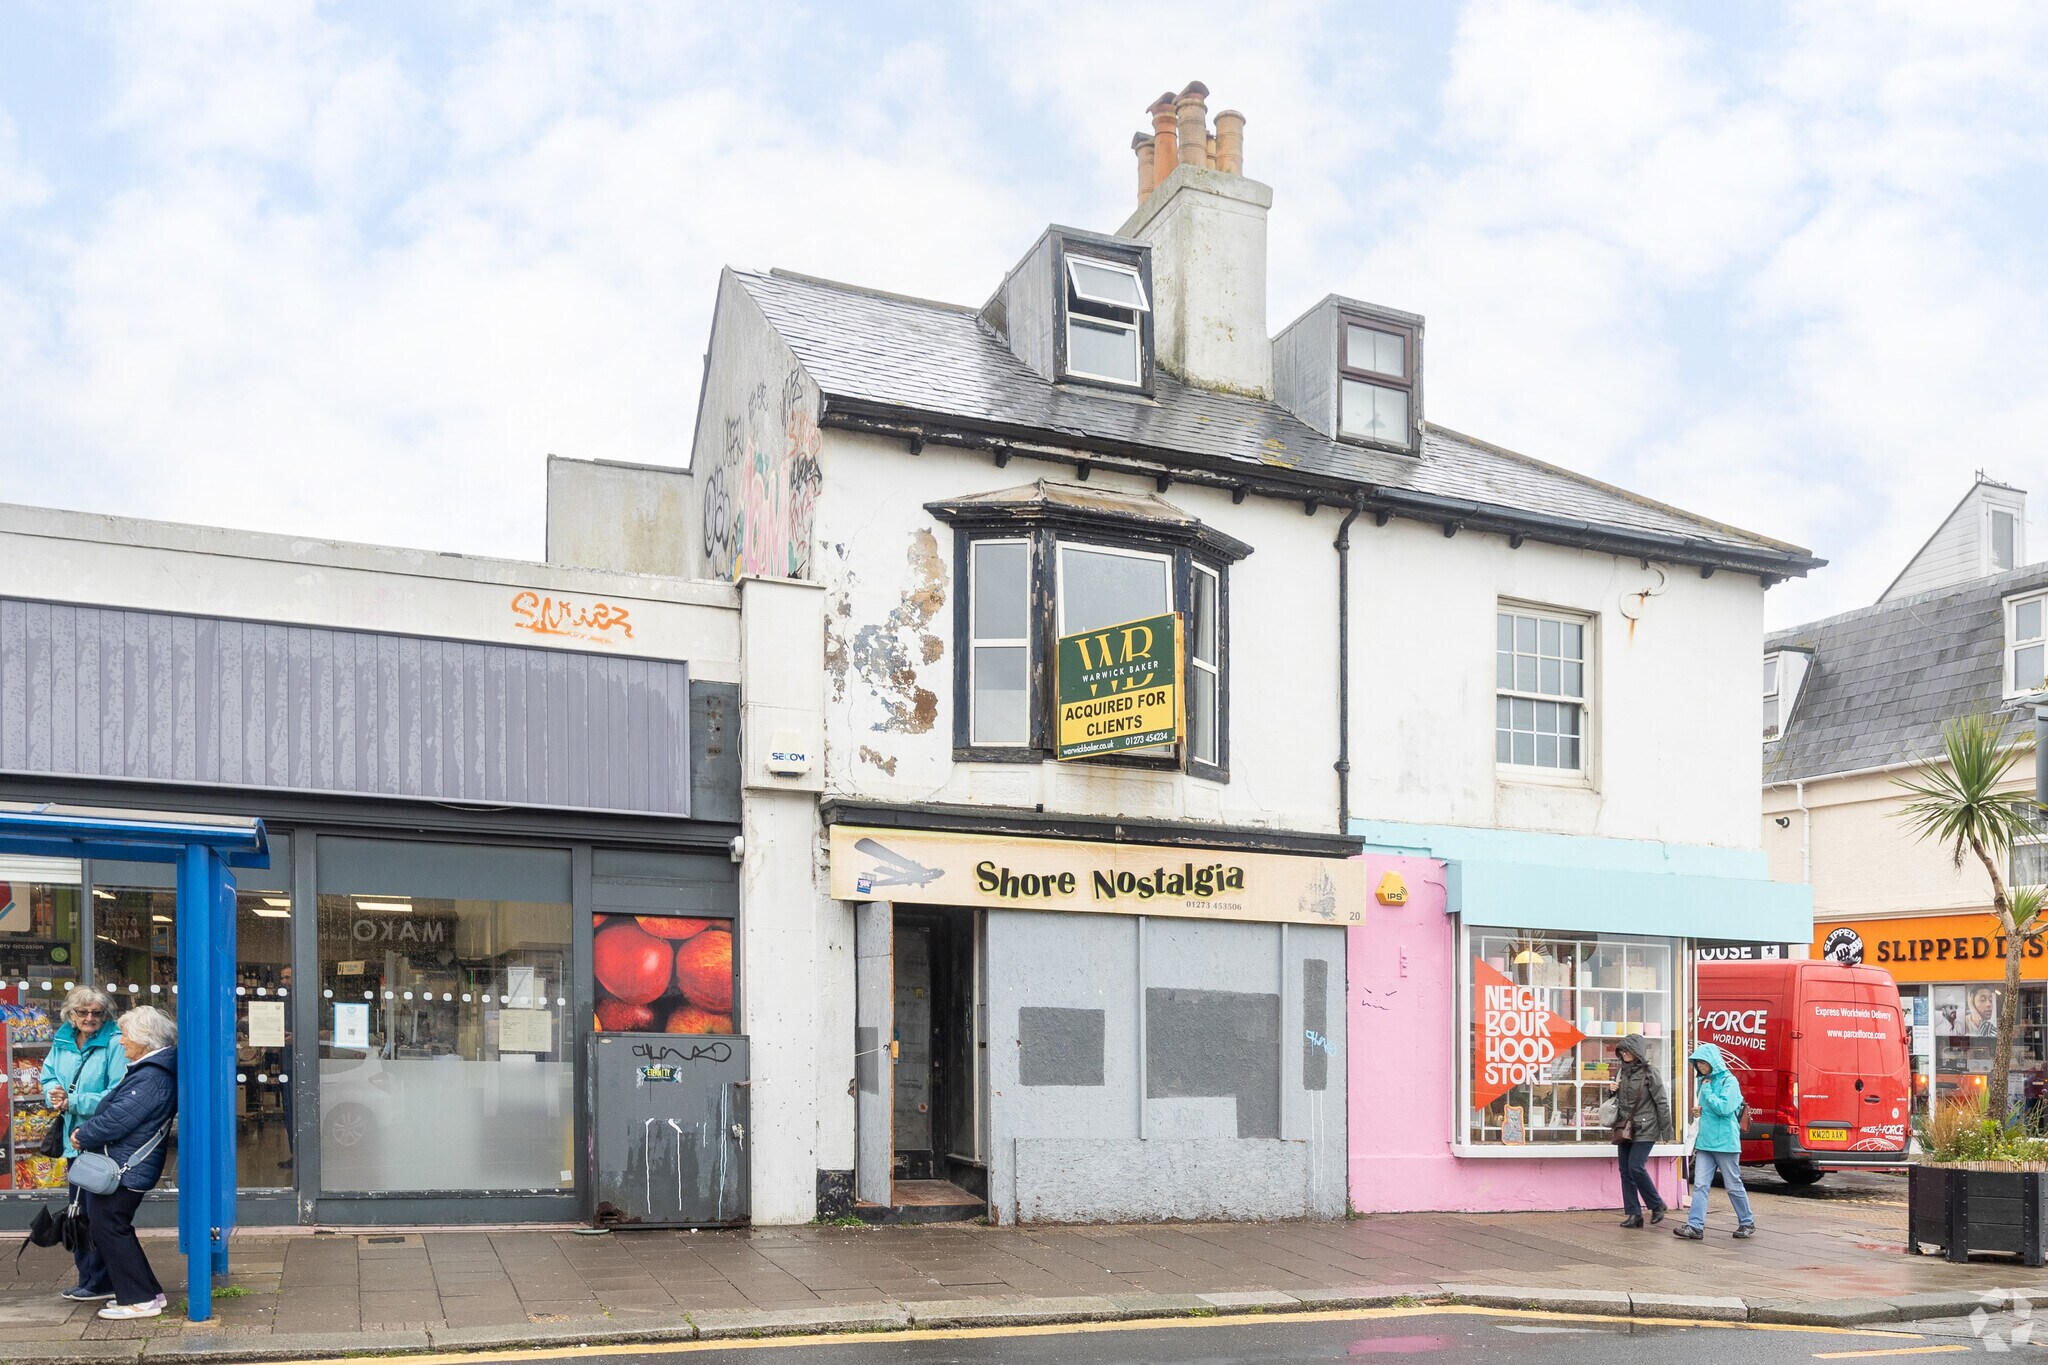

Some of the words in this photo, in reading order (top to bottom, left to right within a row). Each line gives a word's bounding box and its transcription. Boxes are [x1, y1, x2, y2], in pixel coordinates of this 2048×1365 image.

[1082, 667, 1125, 682] WARWICK
[1129, 660, 1159, 674] BAKER
[1065, 696, 1133, 721] ACQUIRED
[1138, 691, 1166, 708] FOR
[1086, 714, 1143, 737] CLIENTS
[1063, 740, 1114, 755] warwickbaker.co.uk
[1125, 735, 1144, 746] 01273
[1145, 732, 1168, 743] 454234
[771, 752, 805, 761] SECOM
[976, 860, 1076, 898] Shore
[1093, 863, 1244, 899] Nostalgia
[1186, 901, 1211, 909] 01273
[1213, 903, 1242, 911] 453506
[1387, 892, 1402, 900] IPS
[1349, 911, 1360, 921] 20
[1823, 928, 1857, 952] SLIPPED
[1877, 936, 1990, 962] SLIPPED
[1485, 985, 1550, 1011] NEIGH
[1485, 1010, 1550, 1037] BOUR
[1703, 1010, 1767, 1035] FORCE
[1815, 1006, 1839, 1018] Express
[1841, 1008, 1870, 1019] Worldwide
[1871, 1009, 1892, 1022] Delivery
[1712, 1033, 1766, 1051] WORLDWIDE
[1826, 1028, 1887, 1040] www.parcelforce.com
[1485, 1037, 1554, 1063] HOOD
[1484, 1062, 1552, 1085] STORE
[1812, 1130, 1830, 1139] KM20
[1832, 1131, 1844, 1139] AAK
